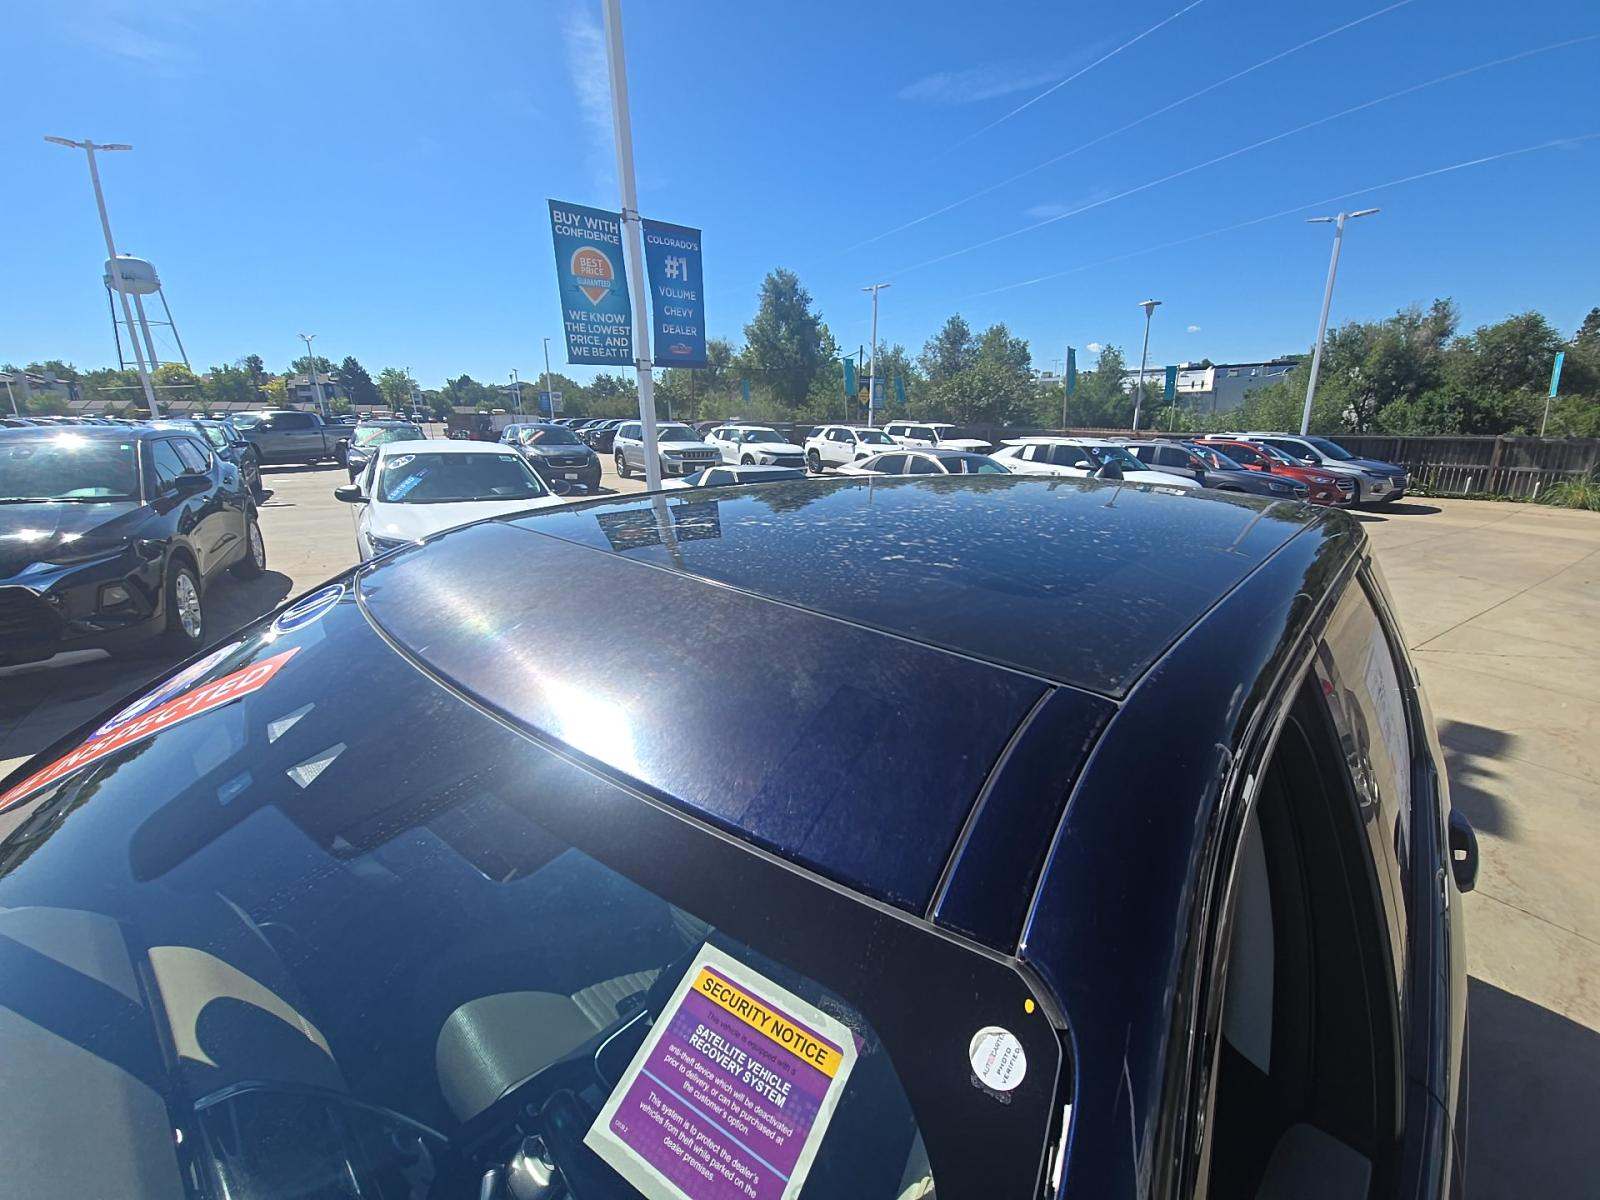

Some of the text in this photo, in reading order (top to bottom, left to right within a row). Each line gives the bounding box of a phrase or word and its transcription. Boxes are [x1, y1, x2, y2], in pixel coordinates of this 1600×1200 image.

[553, 210, 618, 234] BUY WITH
[555, 225, 620, 245] CONFIDENCE
[647, 234, 699, 251] COLORADO'S
[579, 257, 603, 269] BEST
[580, 266, 605, 276] PRICE
[664, 255, 688, 282] #1
[659, 286, 697, 301] VOLUME
[568, 309, 626, 324] WE KNOW
[664, 306, 694, 318] CHEVY
[565, 321, 631, 335] THE LOWEST
[570, 334, 629, 347] PRICE, AND
[662, 323, 698, 337] DEALER
[570, 346, 630, 358] WE BEAT IT
[703, 978, 828, 1065] SECURITY NOTICE
[689, 1033, 787, 1108] RECOVERY SYSTEM
[695, 1023, 792, 1095] SATELLITE VEHICLE
[997, 1047, 1012, 1076] PHOTO
[1001, 1047, 1021, 1084] VERIFIED
[664, 1054, 680, 1068] prior
[679, 1064, 686, 1073] to
[710, 1088, 718, 1097] or
[718, 1093, 731, 1107] can
[730, 1101, 740, 1113] be
[739, 1110, 776, 1140] purchased
[775, 1136, 784, 1146] at
[668, 1044, 793, 1137] anti-theft device which will be deactivated
[683, 1080, 749, 1135] the customer's option.
[640, 1101, 757, 1199] vehicles from theft while parked on the
[648, 1091, 760, 1184] This system is to protect the dealer's
[663, 1136, 714, 1182] dealer premises.
